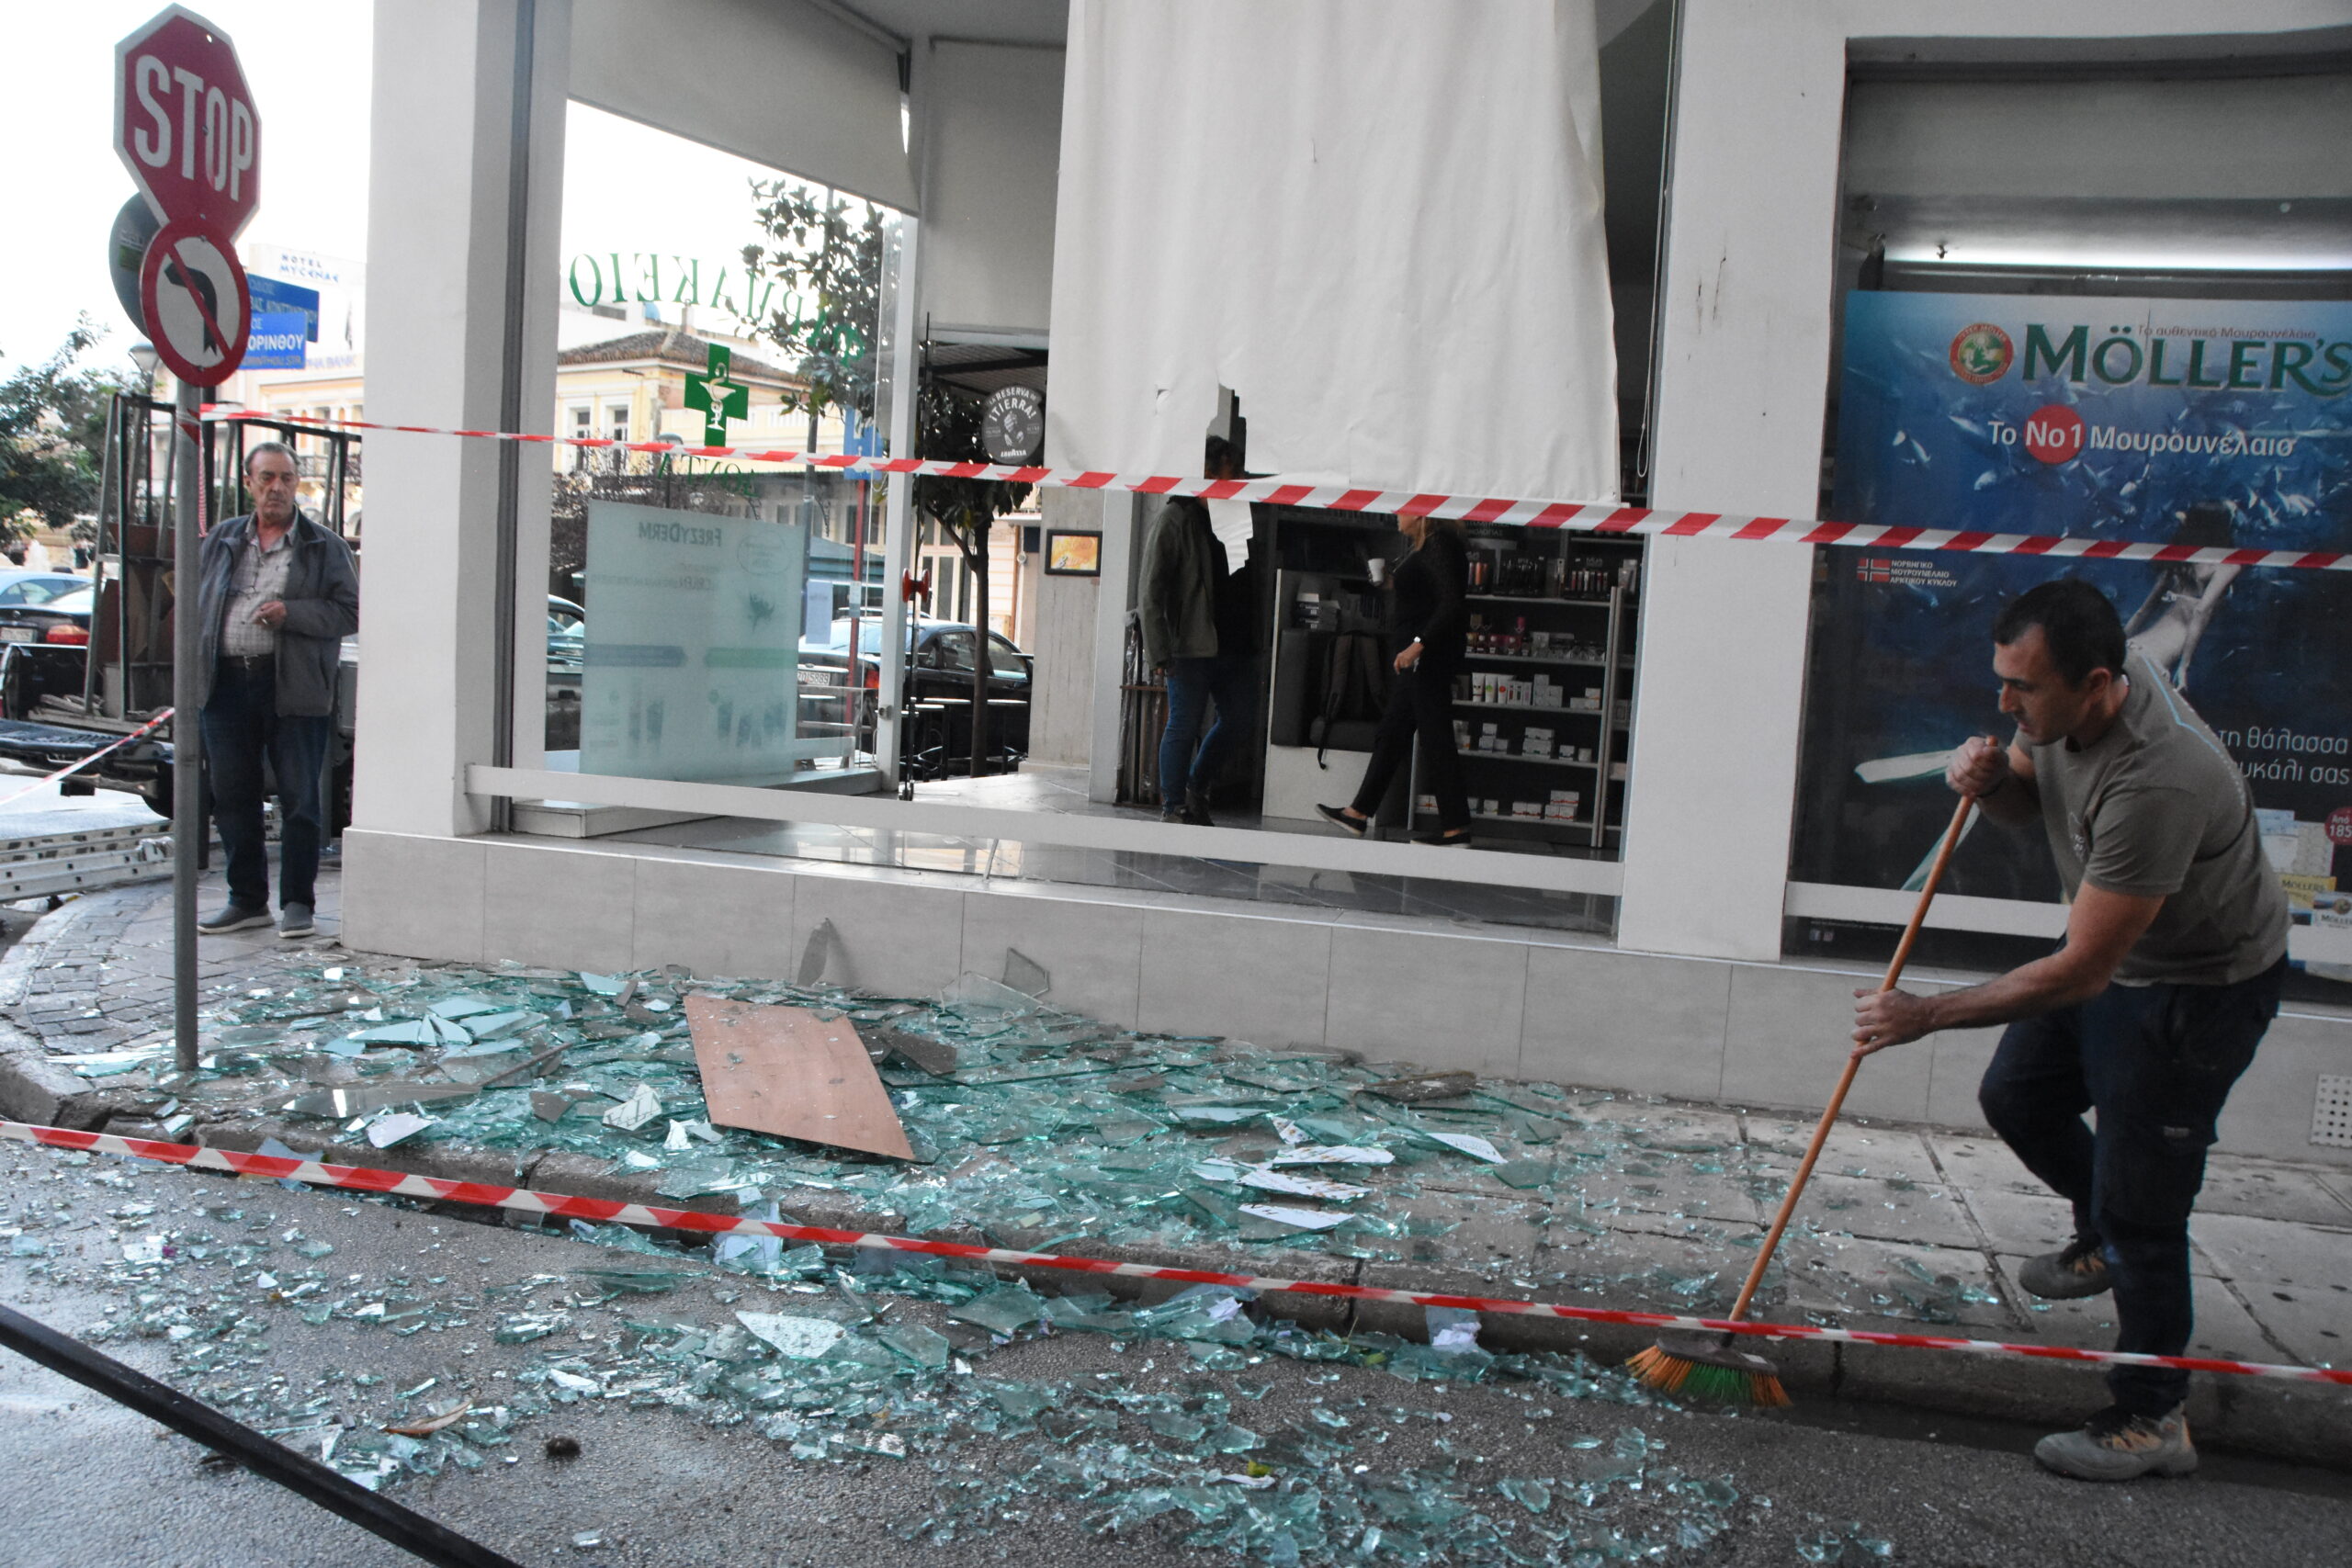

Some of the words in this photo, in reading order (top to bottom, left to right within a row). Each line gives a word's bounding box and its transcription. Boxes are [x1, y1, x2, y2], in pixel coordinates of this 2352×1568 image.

[135, 55, 253, 202] STOP
[281, 254, 322, 268] HOTEL
[248, 333, 303, 351] ΟΡΙΝΘΟΥ
[2022, 323, 2352, 399] MÖLLER'S
[995, 387, 1029, 401] RESERVA
[1987, 421, 2018, 446] Το
[2089, 425, 2297, 457] Μουρουνέλαιο
[1891, 559, 1933, 570] ΝΟΡΒΗΓΙΚΟ
[1890, 569, 1950, 579] ΜΟΥΡΟΥΝΕΛΑΙΟ
[1927, 578, 1957, 588] ΚΥΚΛΟΥ
[2247, 726, 2348, 754] θάλασσα
[2240, 759, 2302, 782] υκάλι
[2310, 766, 2350, 785] σας
[2330, 824, 2352, 839] 185
